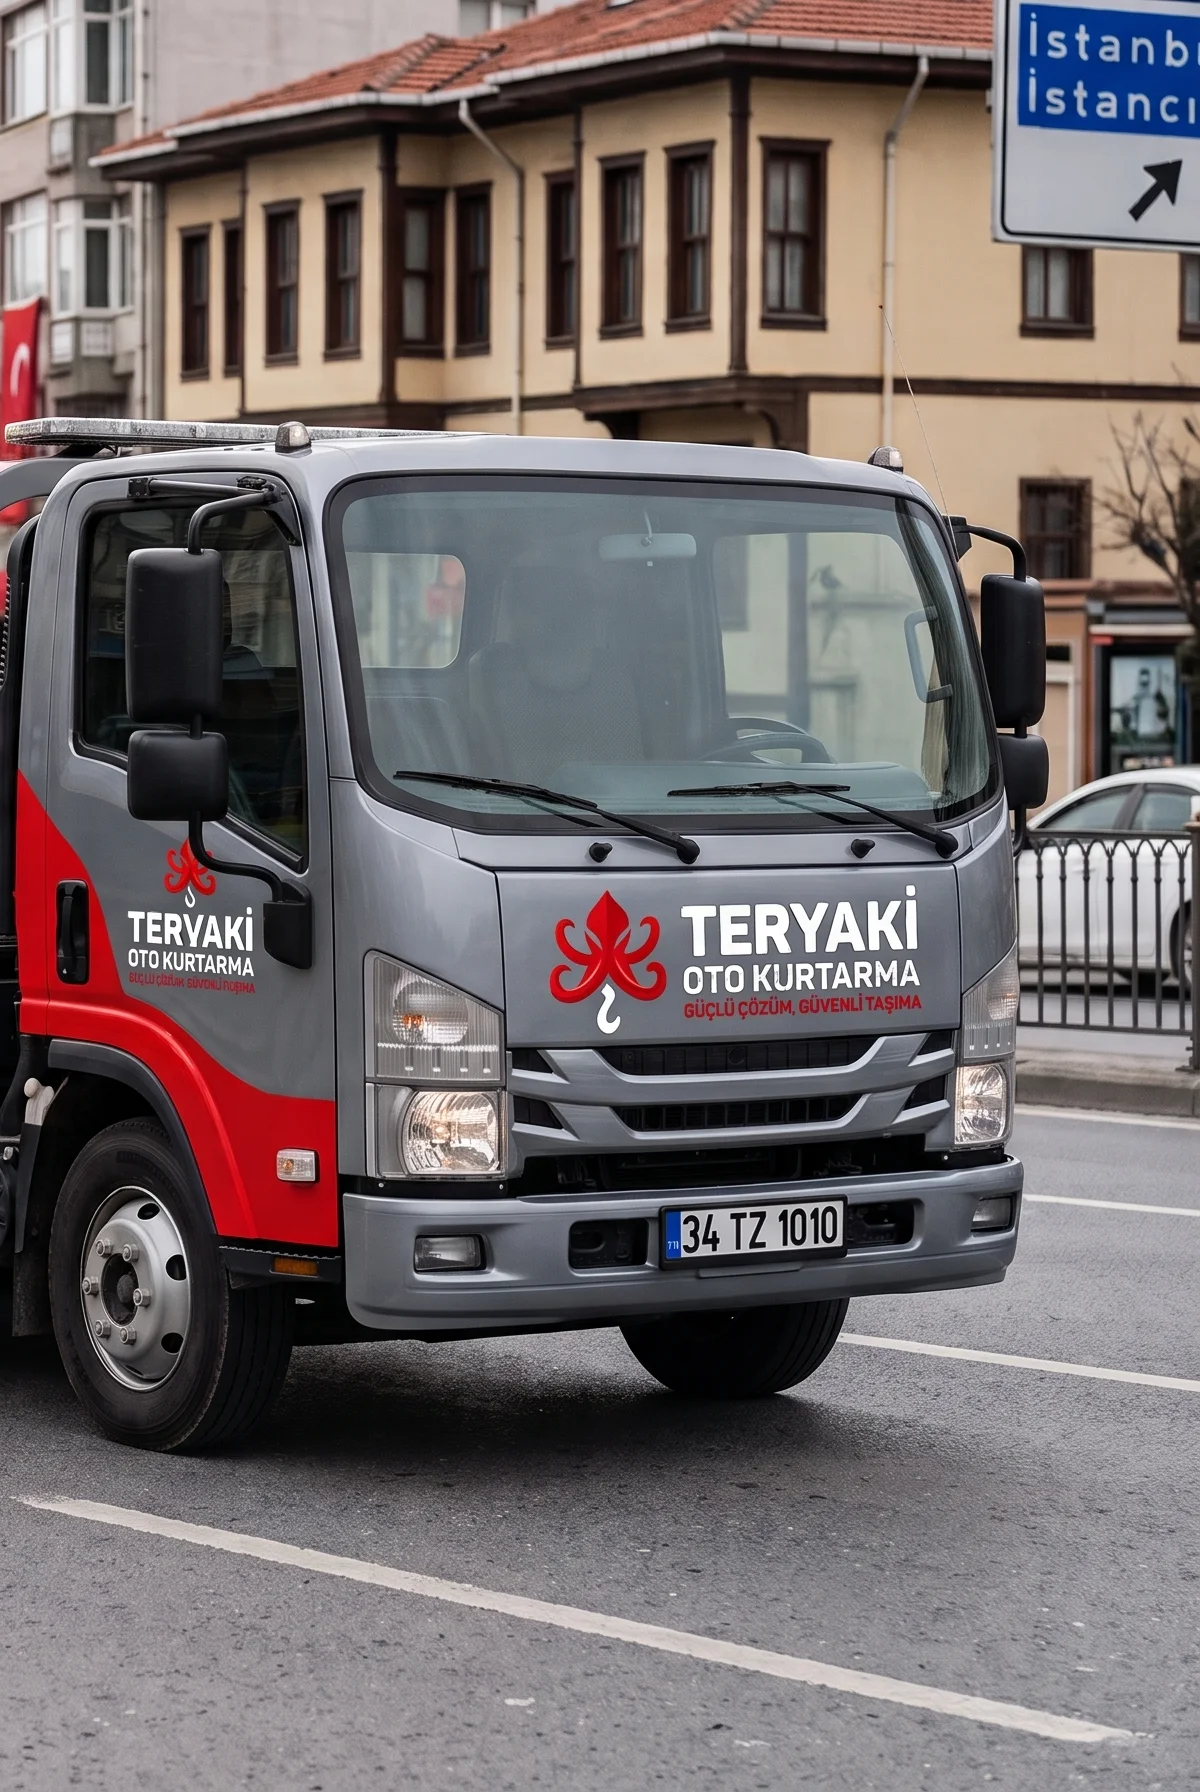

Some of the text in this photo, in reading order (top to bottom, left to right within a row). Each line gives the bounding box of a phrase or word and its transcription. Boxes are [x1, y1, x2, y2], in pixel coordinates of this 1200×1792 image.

[127, 906, 254, 952] TERYAKİ
[680, 884, 919, 957] TERYAKİ
[128, 948, 255, 977] OTO KURTARMA
[683, 959, 921, 995] OTO KURTARMA
[684, 992, 922, 1021] GÜÇLÜ ÇÖZÜM, GÜVENLİ TAŞIMA
[682, 1205, 838, 1254] 34 TZ 1010
